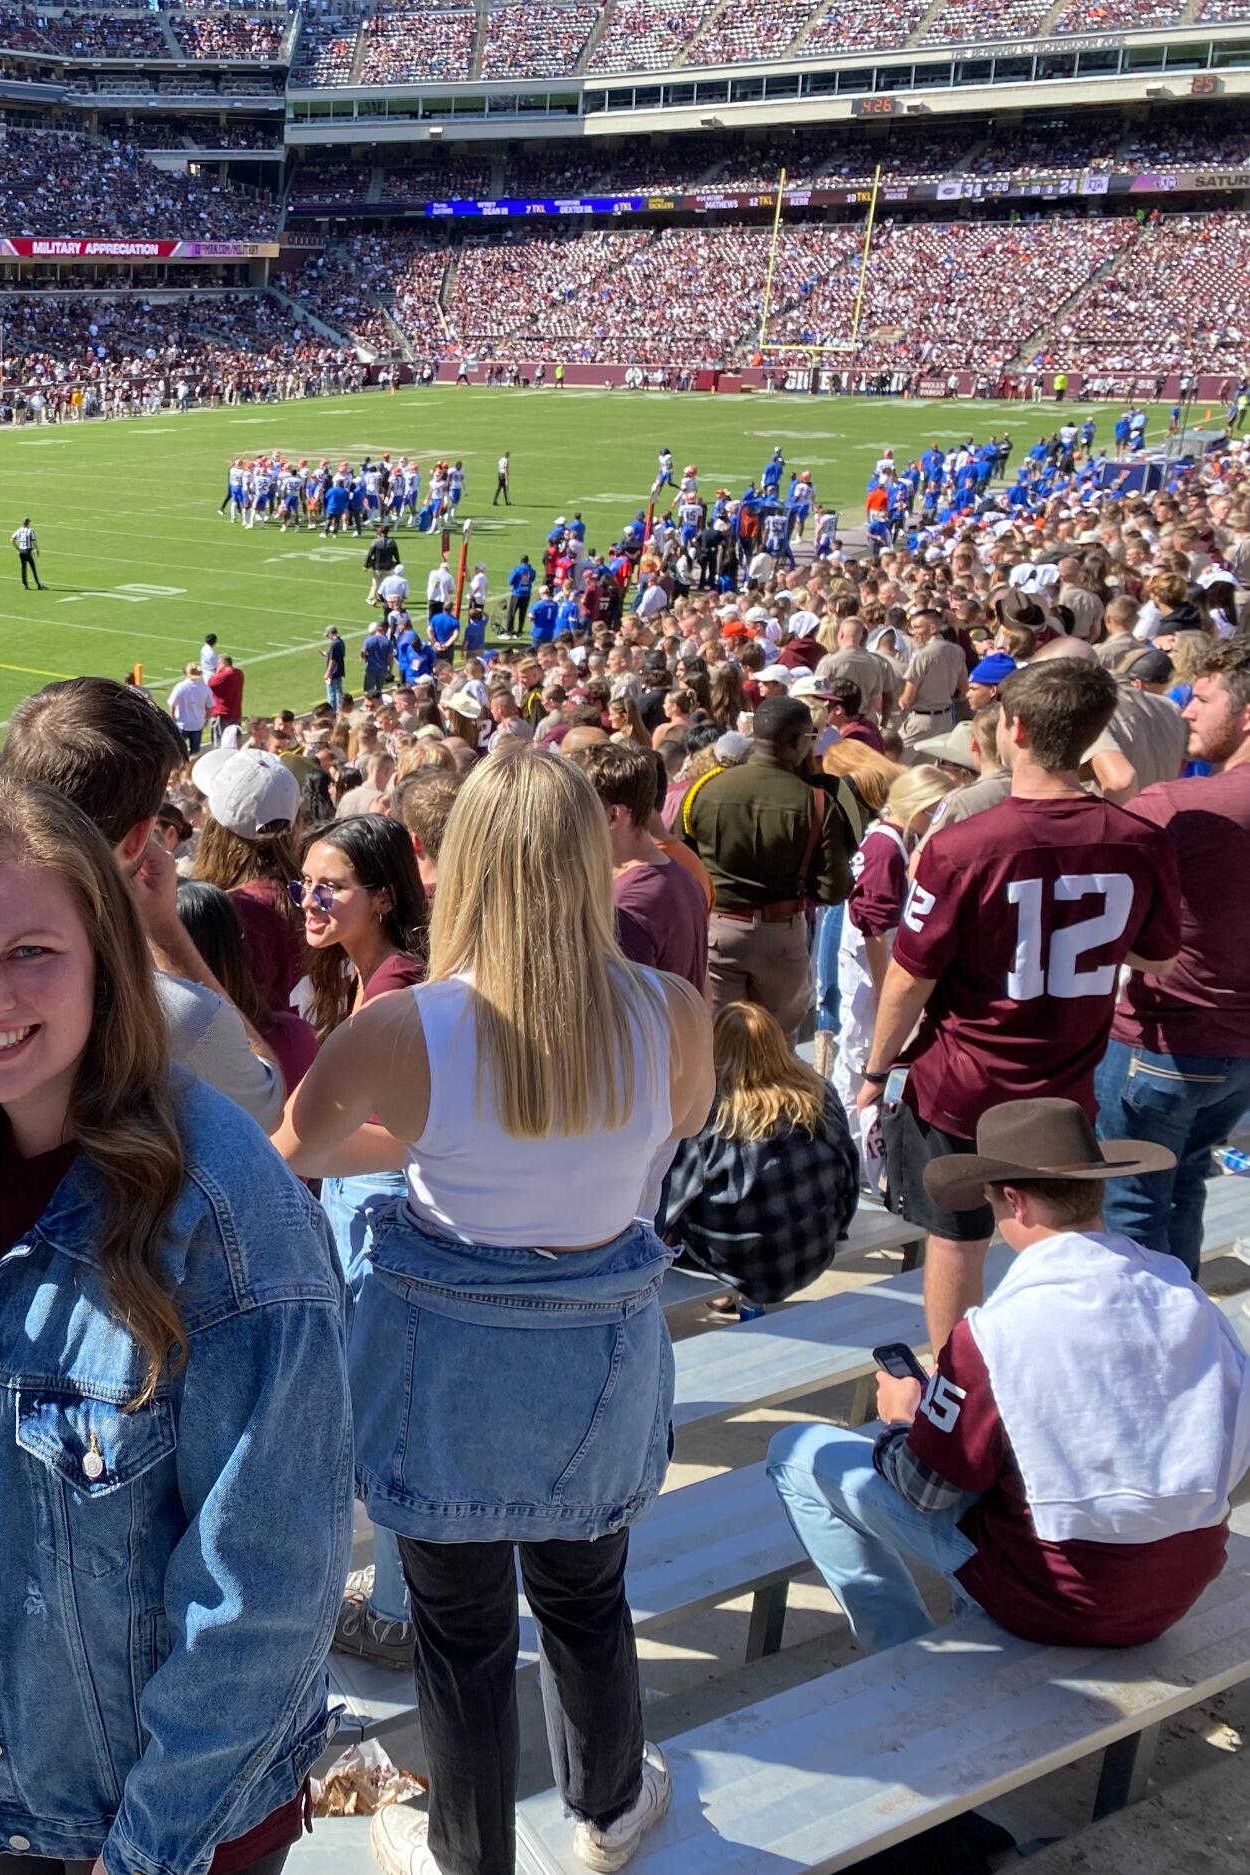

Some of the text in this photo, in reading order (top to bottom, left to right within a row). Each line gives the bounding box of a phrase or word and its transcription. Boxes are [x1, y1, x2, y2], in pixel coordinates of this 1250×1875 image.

[964, 184, 982, 198] 34
[1059, 180, 1078, 194] 24
[32, 241, 158, 255] MILITARY APPRECIATION
[1007, 873, 1134, 1000] 12
